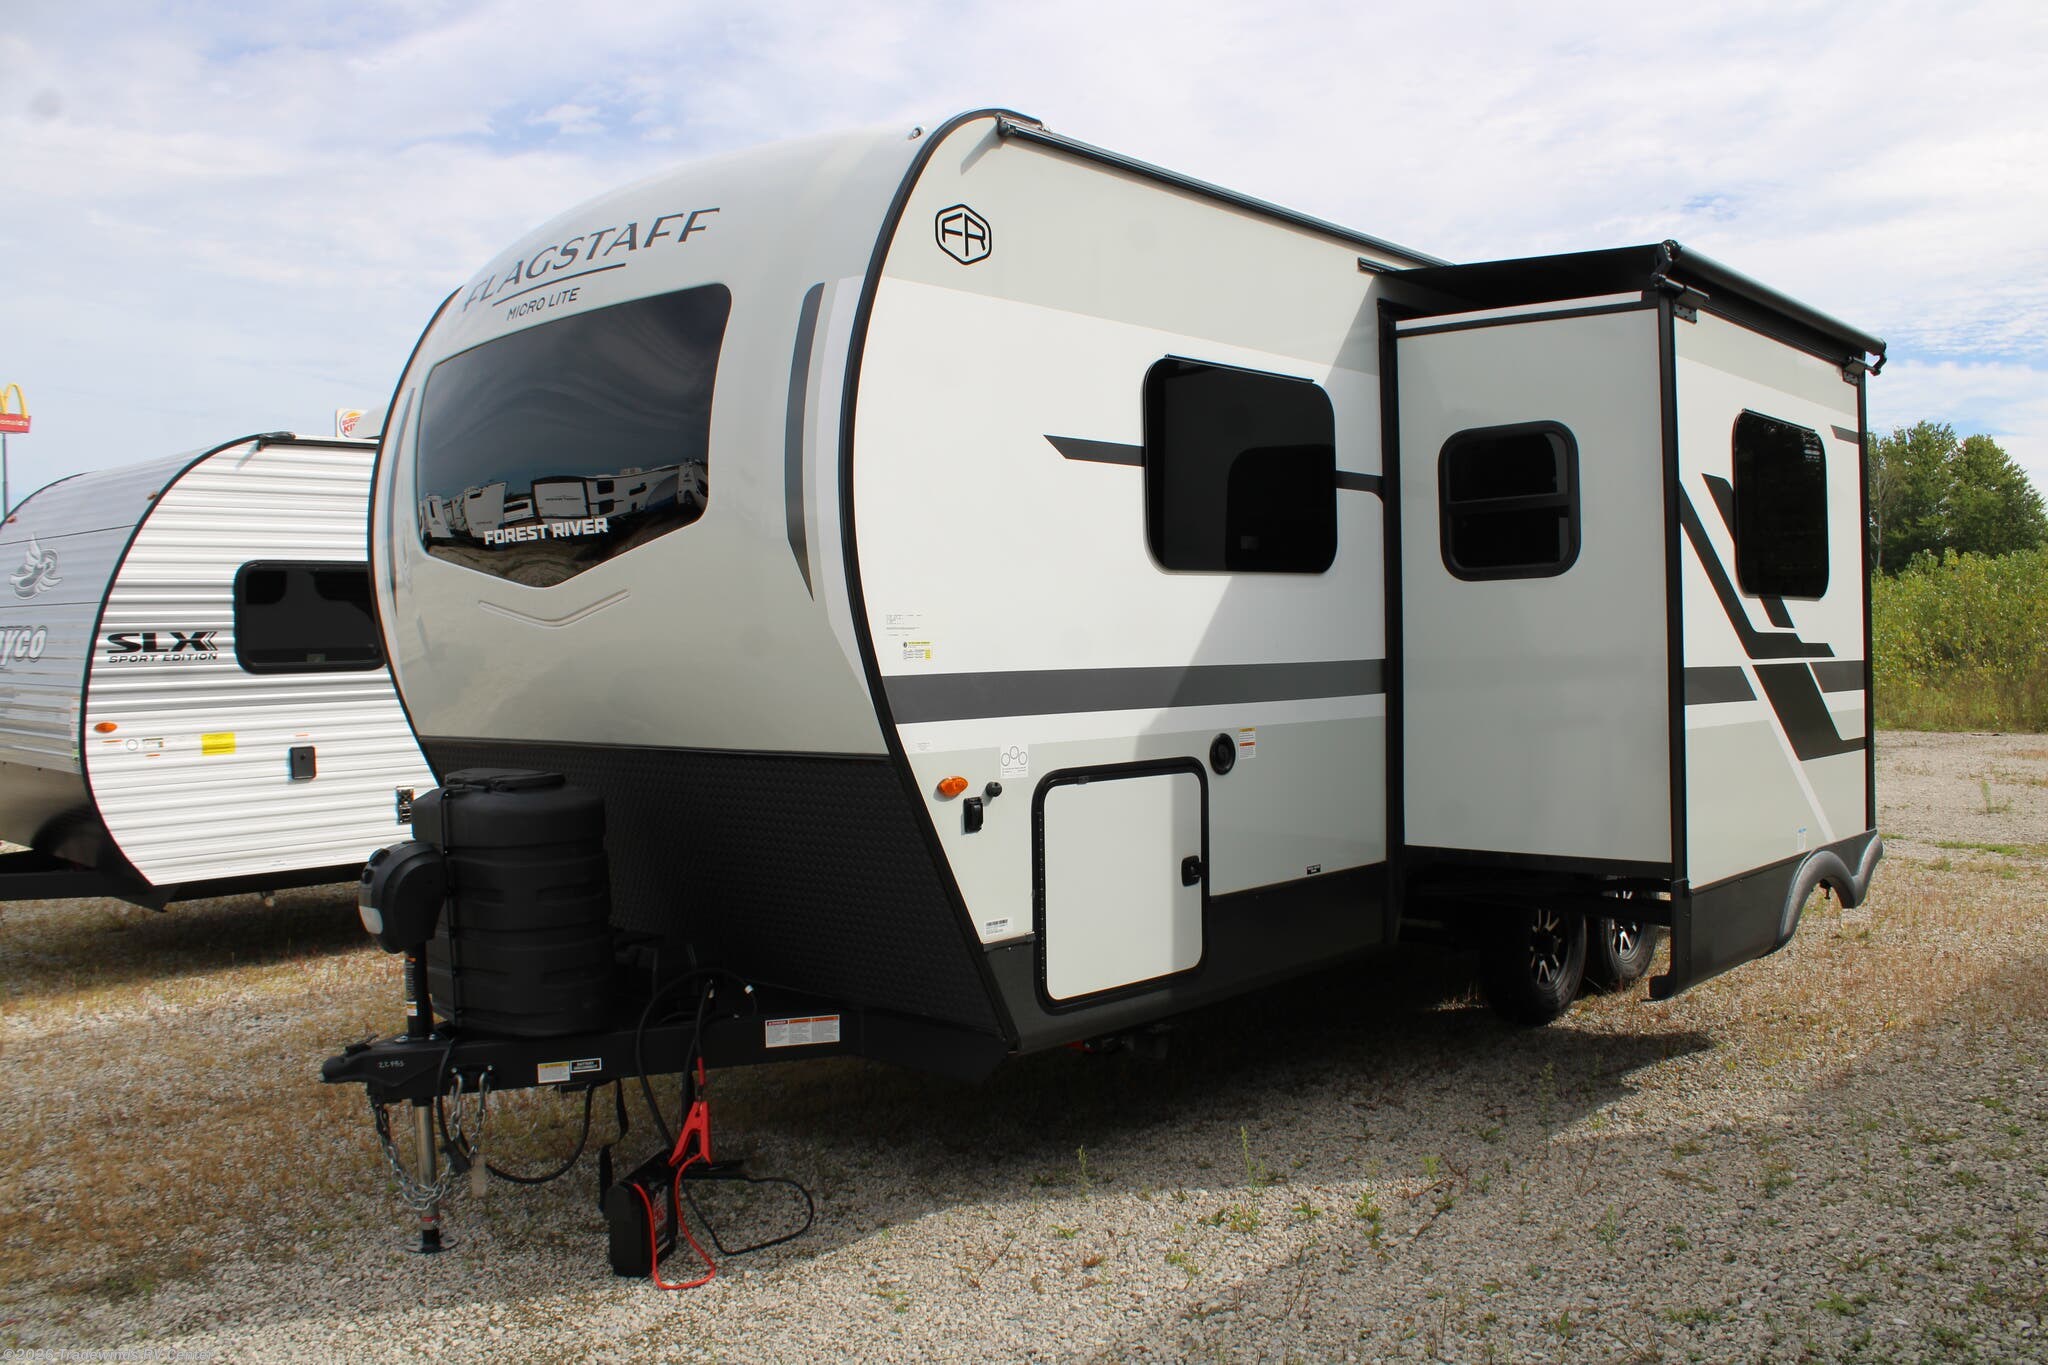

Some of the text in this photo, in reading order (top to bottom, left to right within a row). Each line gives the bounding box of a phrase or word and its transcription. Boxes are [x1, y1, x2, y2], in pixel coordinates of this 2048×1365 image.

[463, 207, 720, 312] FLAGSTAFF
[506, 287, 581, 321] MICRO LITE
[484, 517, 609, 545] FOREST RIVER
[107, 631, 214, 654] SLX
[108, 653, 218, 663] SPORT EDITION
